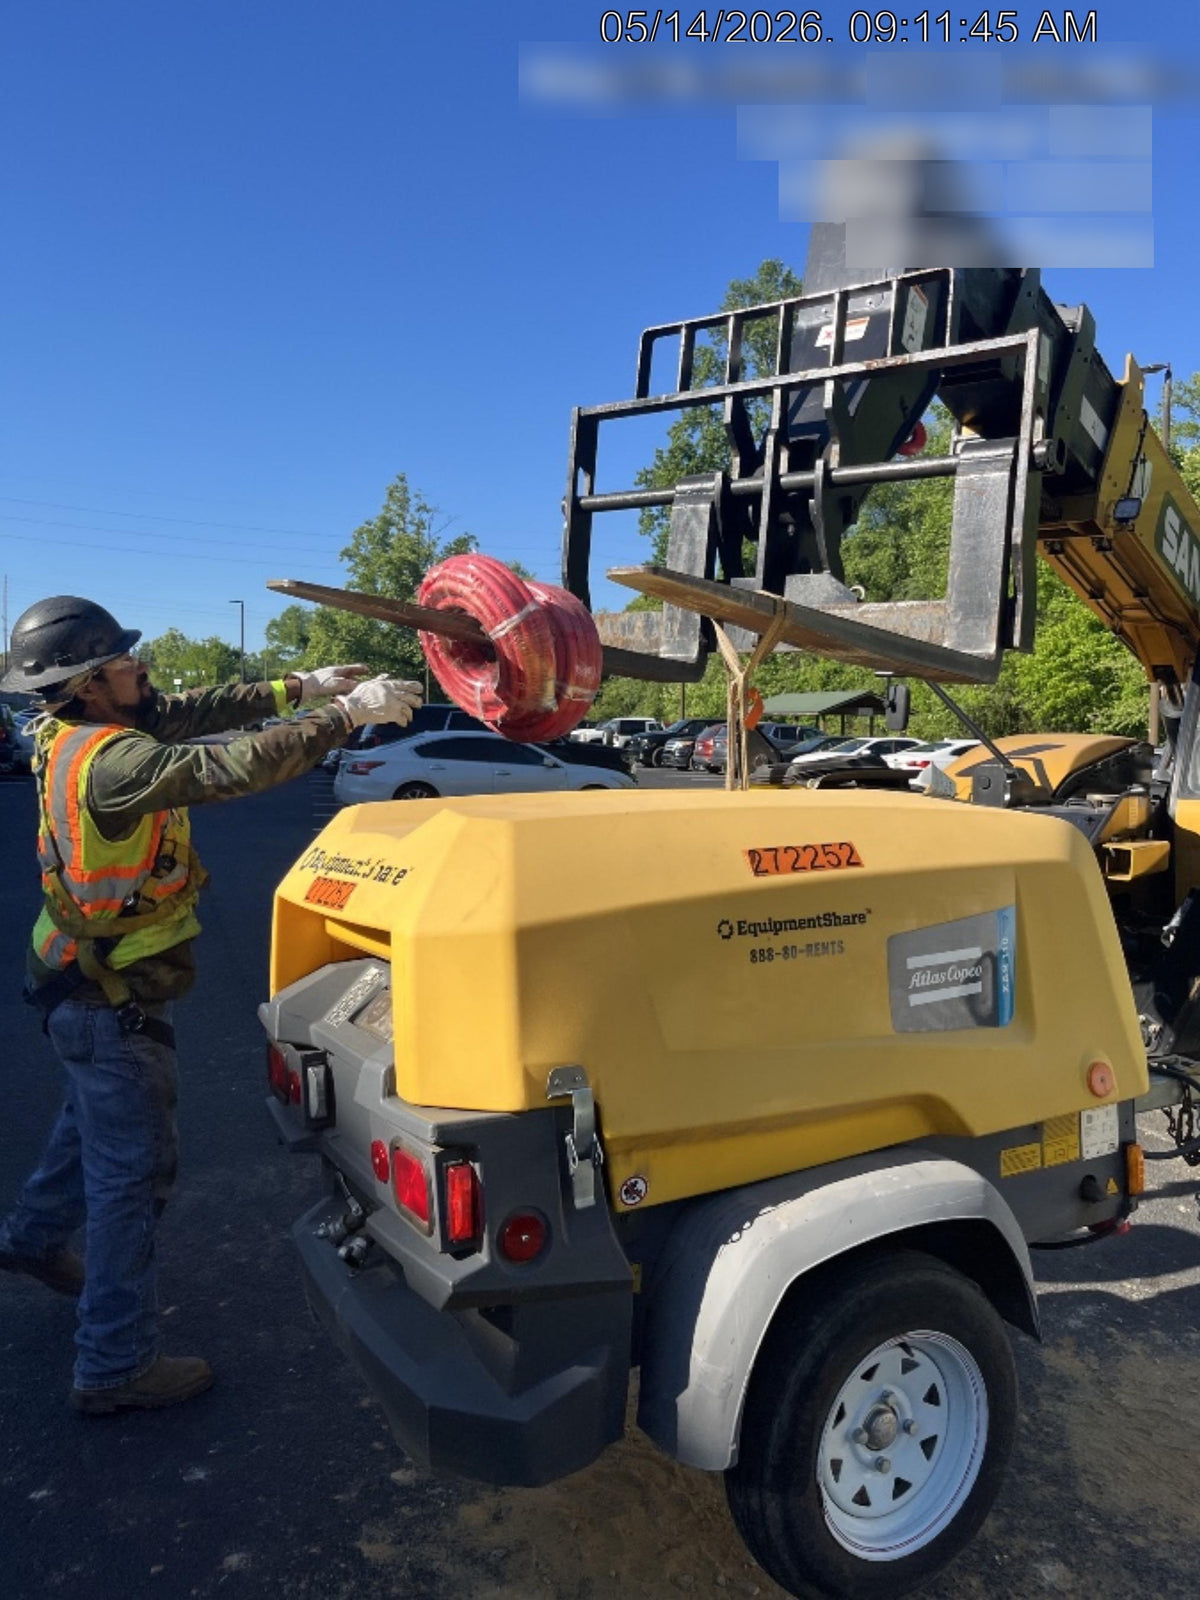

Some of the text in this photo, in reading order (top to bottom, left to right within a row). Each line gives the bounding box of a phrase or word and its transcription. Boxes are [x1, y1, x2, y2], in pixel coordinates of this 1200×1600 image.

[748, 842, 862, 876] 272252
[737, 911, 867, 937] EquipmentShare
[750, 940, 844, 964] 888-80-RENTS
[908, 964, 983, 989] Atlas Copco
